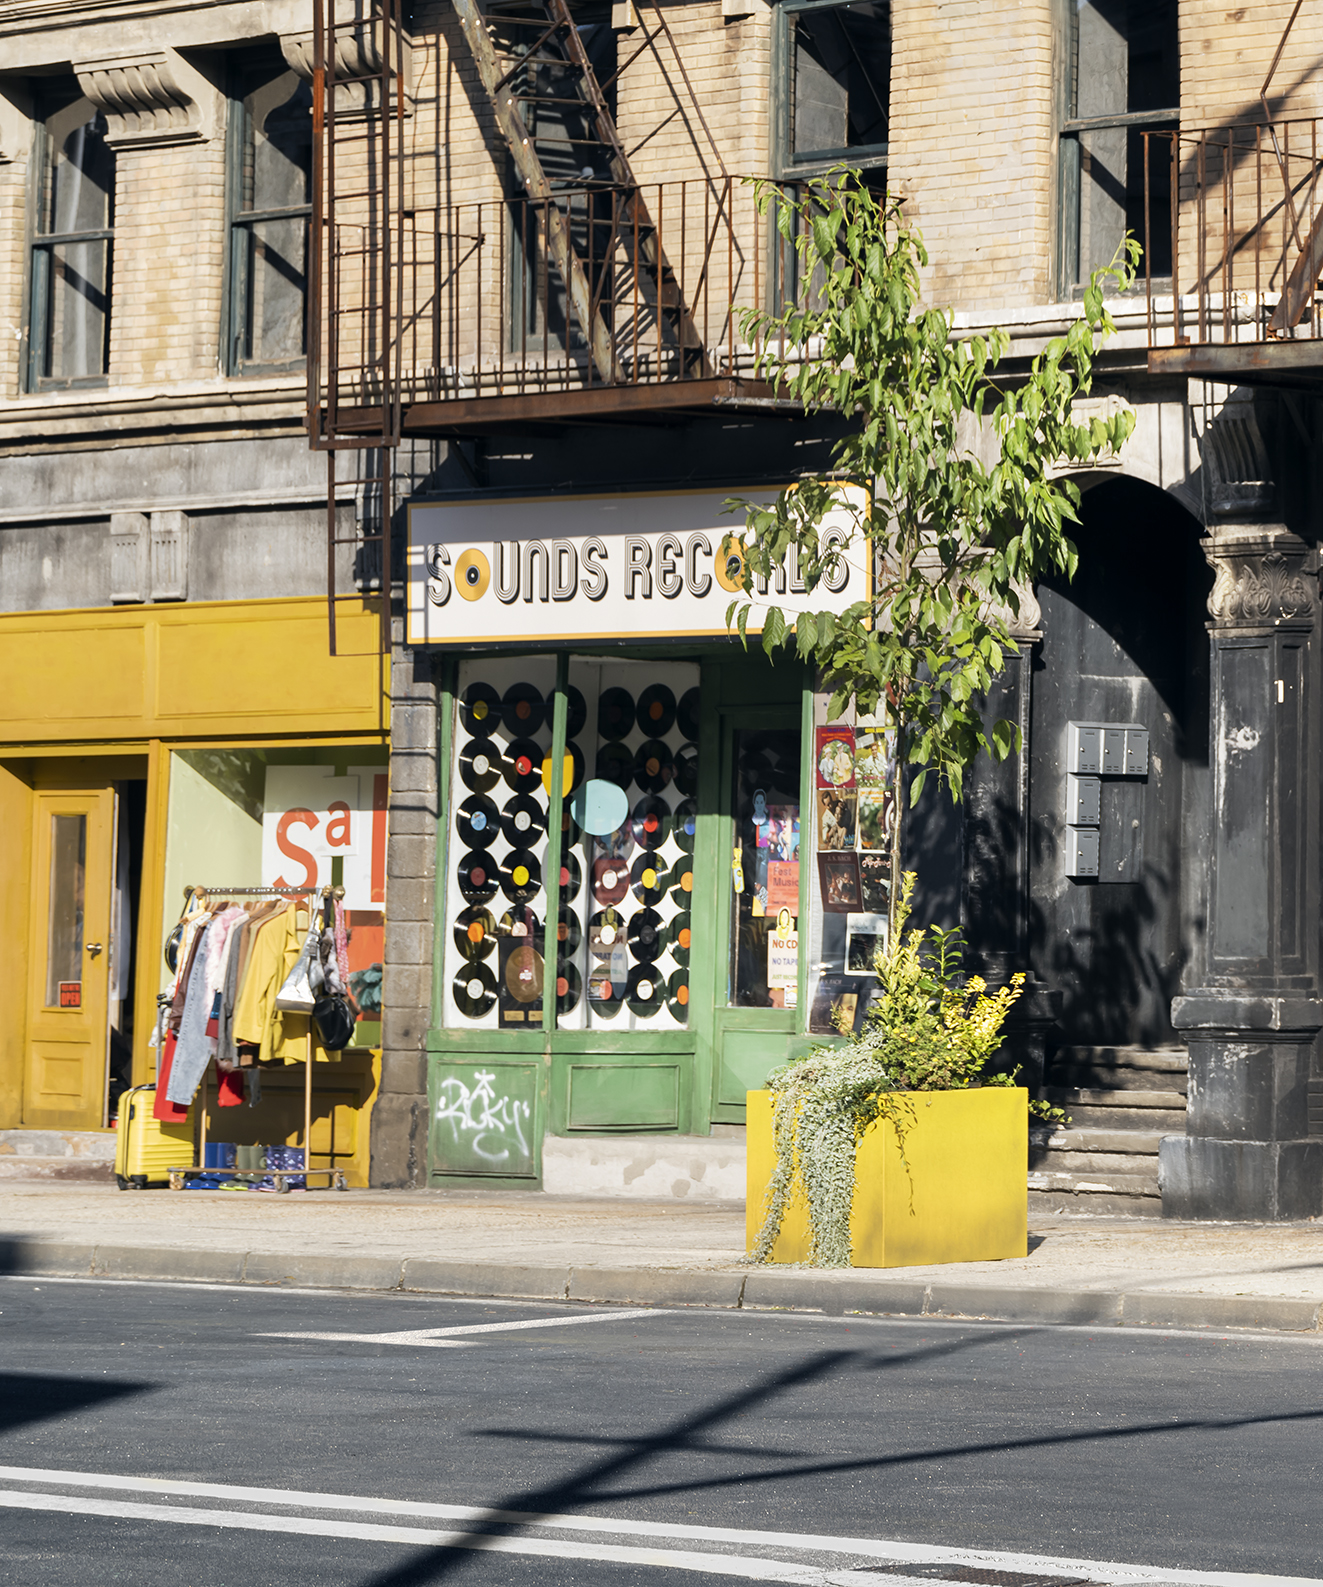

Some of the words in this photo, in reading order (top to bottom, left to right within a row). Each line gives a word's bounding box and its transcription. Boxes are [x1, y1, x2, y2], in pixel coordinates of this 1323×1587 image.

[426, 535, 609, 607] SOUNDS
[773, 866, 792, 876] Fest
[772, 939, 785, 949] NO
